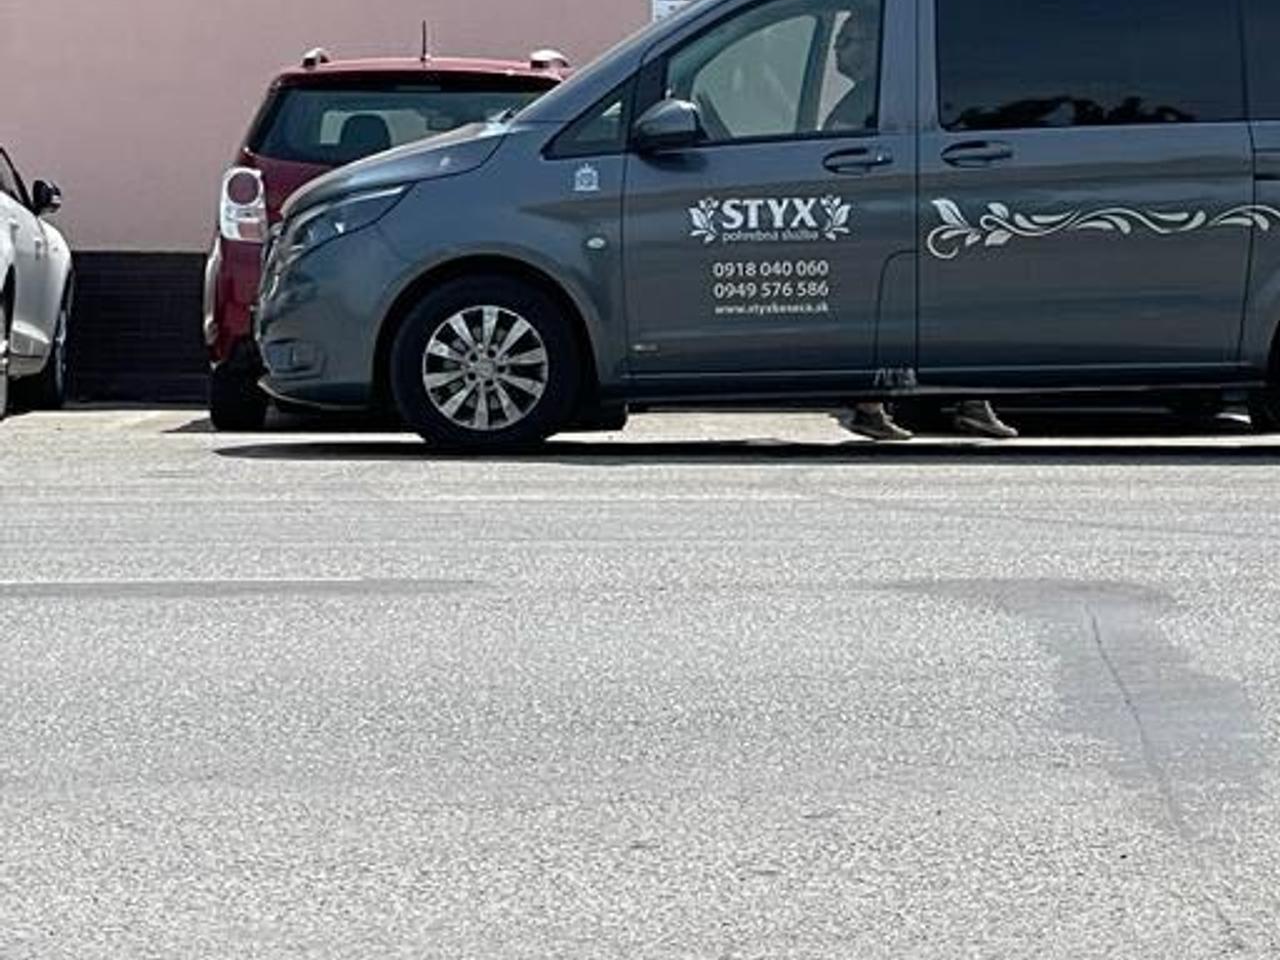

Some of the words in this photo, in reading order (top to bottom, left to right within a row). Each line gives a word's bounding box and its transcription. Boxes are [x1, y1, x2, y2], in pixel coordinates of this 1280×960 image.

[721, 197, 818, 229] STYX
[713, 261, 757, 277] 0918
[760, 260, 793, 276] 040
[796, 259, 829, 276] 060
[713, 282, 757, 299] 0949
[761, 281, 793, 298] 576
[797, 280, 829, 297] 586
